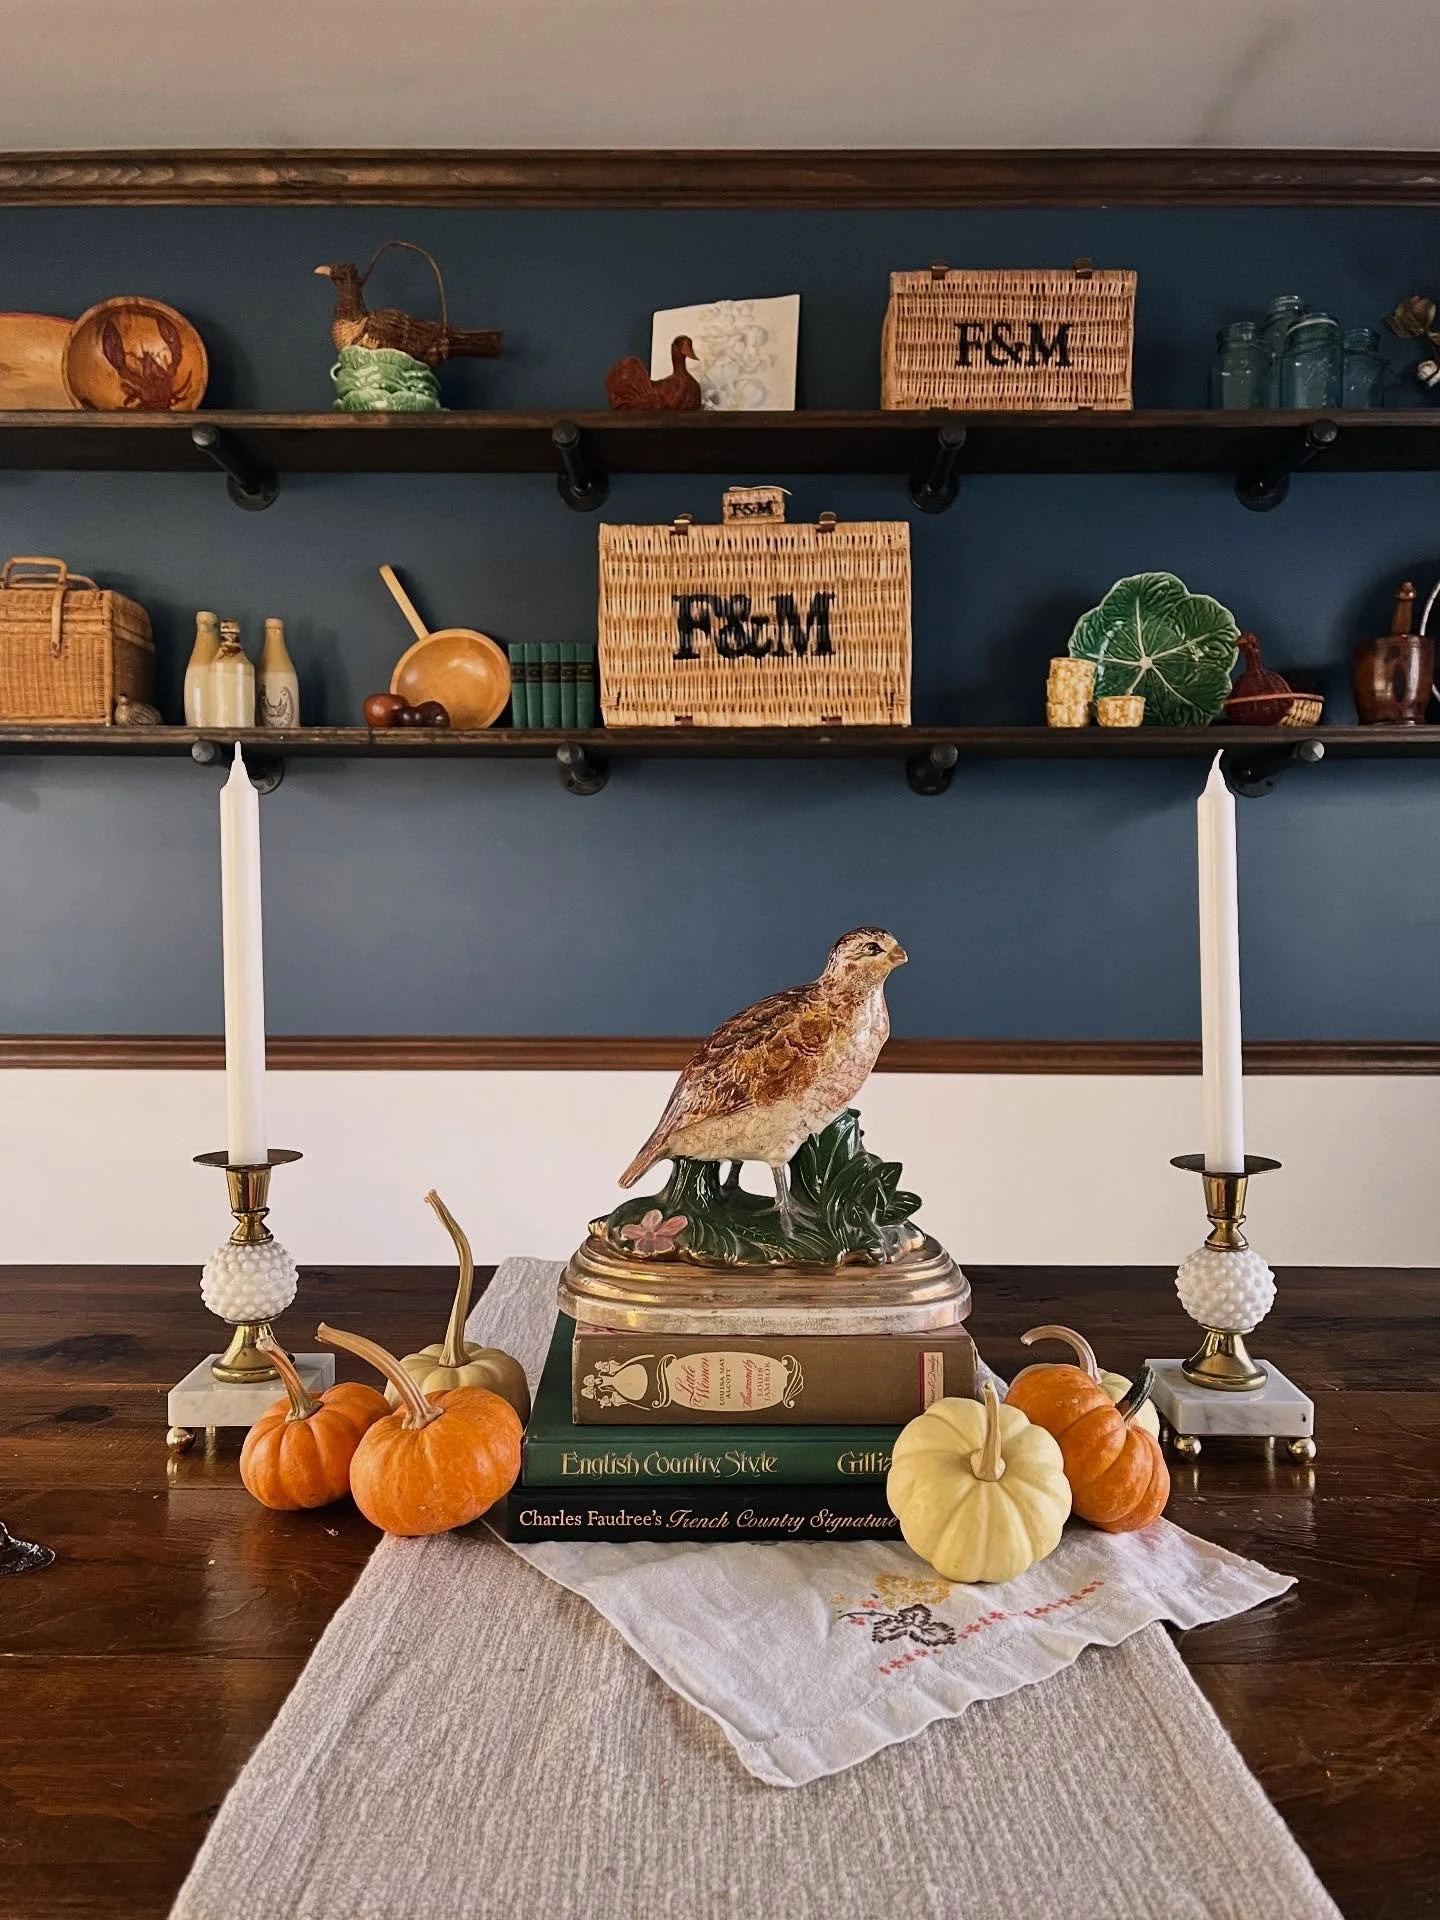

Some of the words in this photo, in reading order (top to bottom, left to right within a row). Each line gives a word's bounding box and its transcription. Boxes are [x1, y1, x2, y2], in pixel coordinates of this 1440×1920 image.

[954, 320, 1074, 369] F&M
[729, 500, 775, 517] F&M
[671, 590, 837, 661] F&M
[674, 1364, 696, 1407] Little
[691, 1357, 711, 1407] Women
[756, 1367, 764, 1397] LOUIS
[560, 1450, 640, 1479] English
[643, 1450, 721, 1478] Country
[723, 1449, 779, 1478] Style
[519, 1509, 582, 1526] Charles
[587, 1509, 662, 1526] Faudree's
[665, 1509, 730, 1529] French
[736, 1509, 805, 1533] Country
[809, 1508, 898, 1533] Signature
